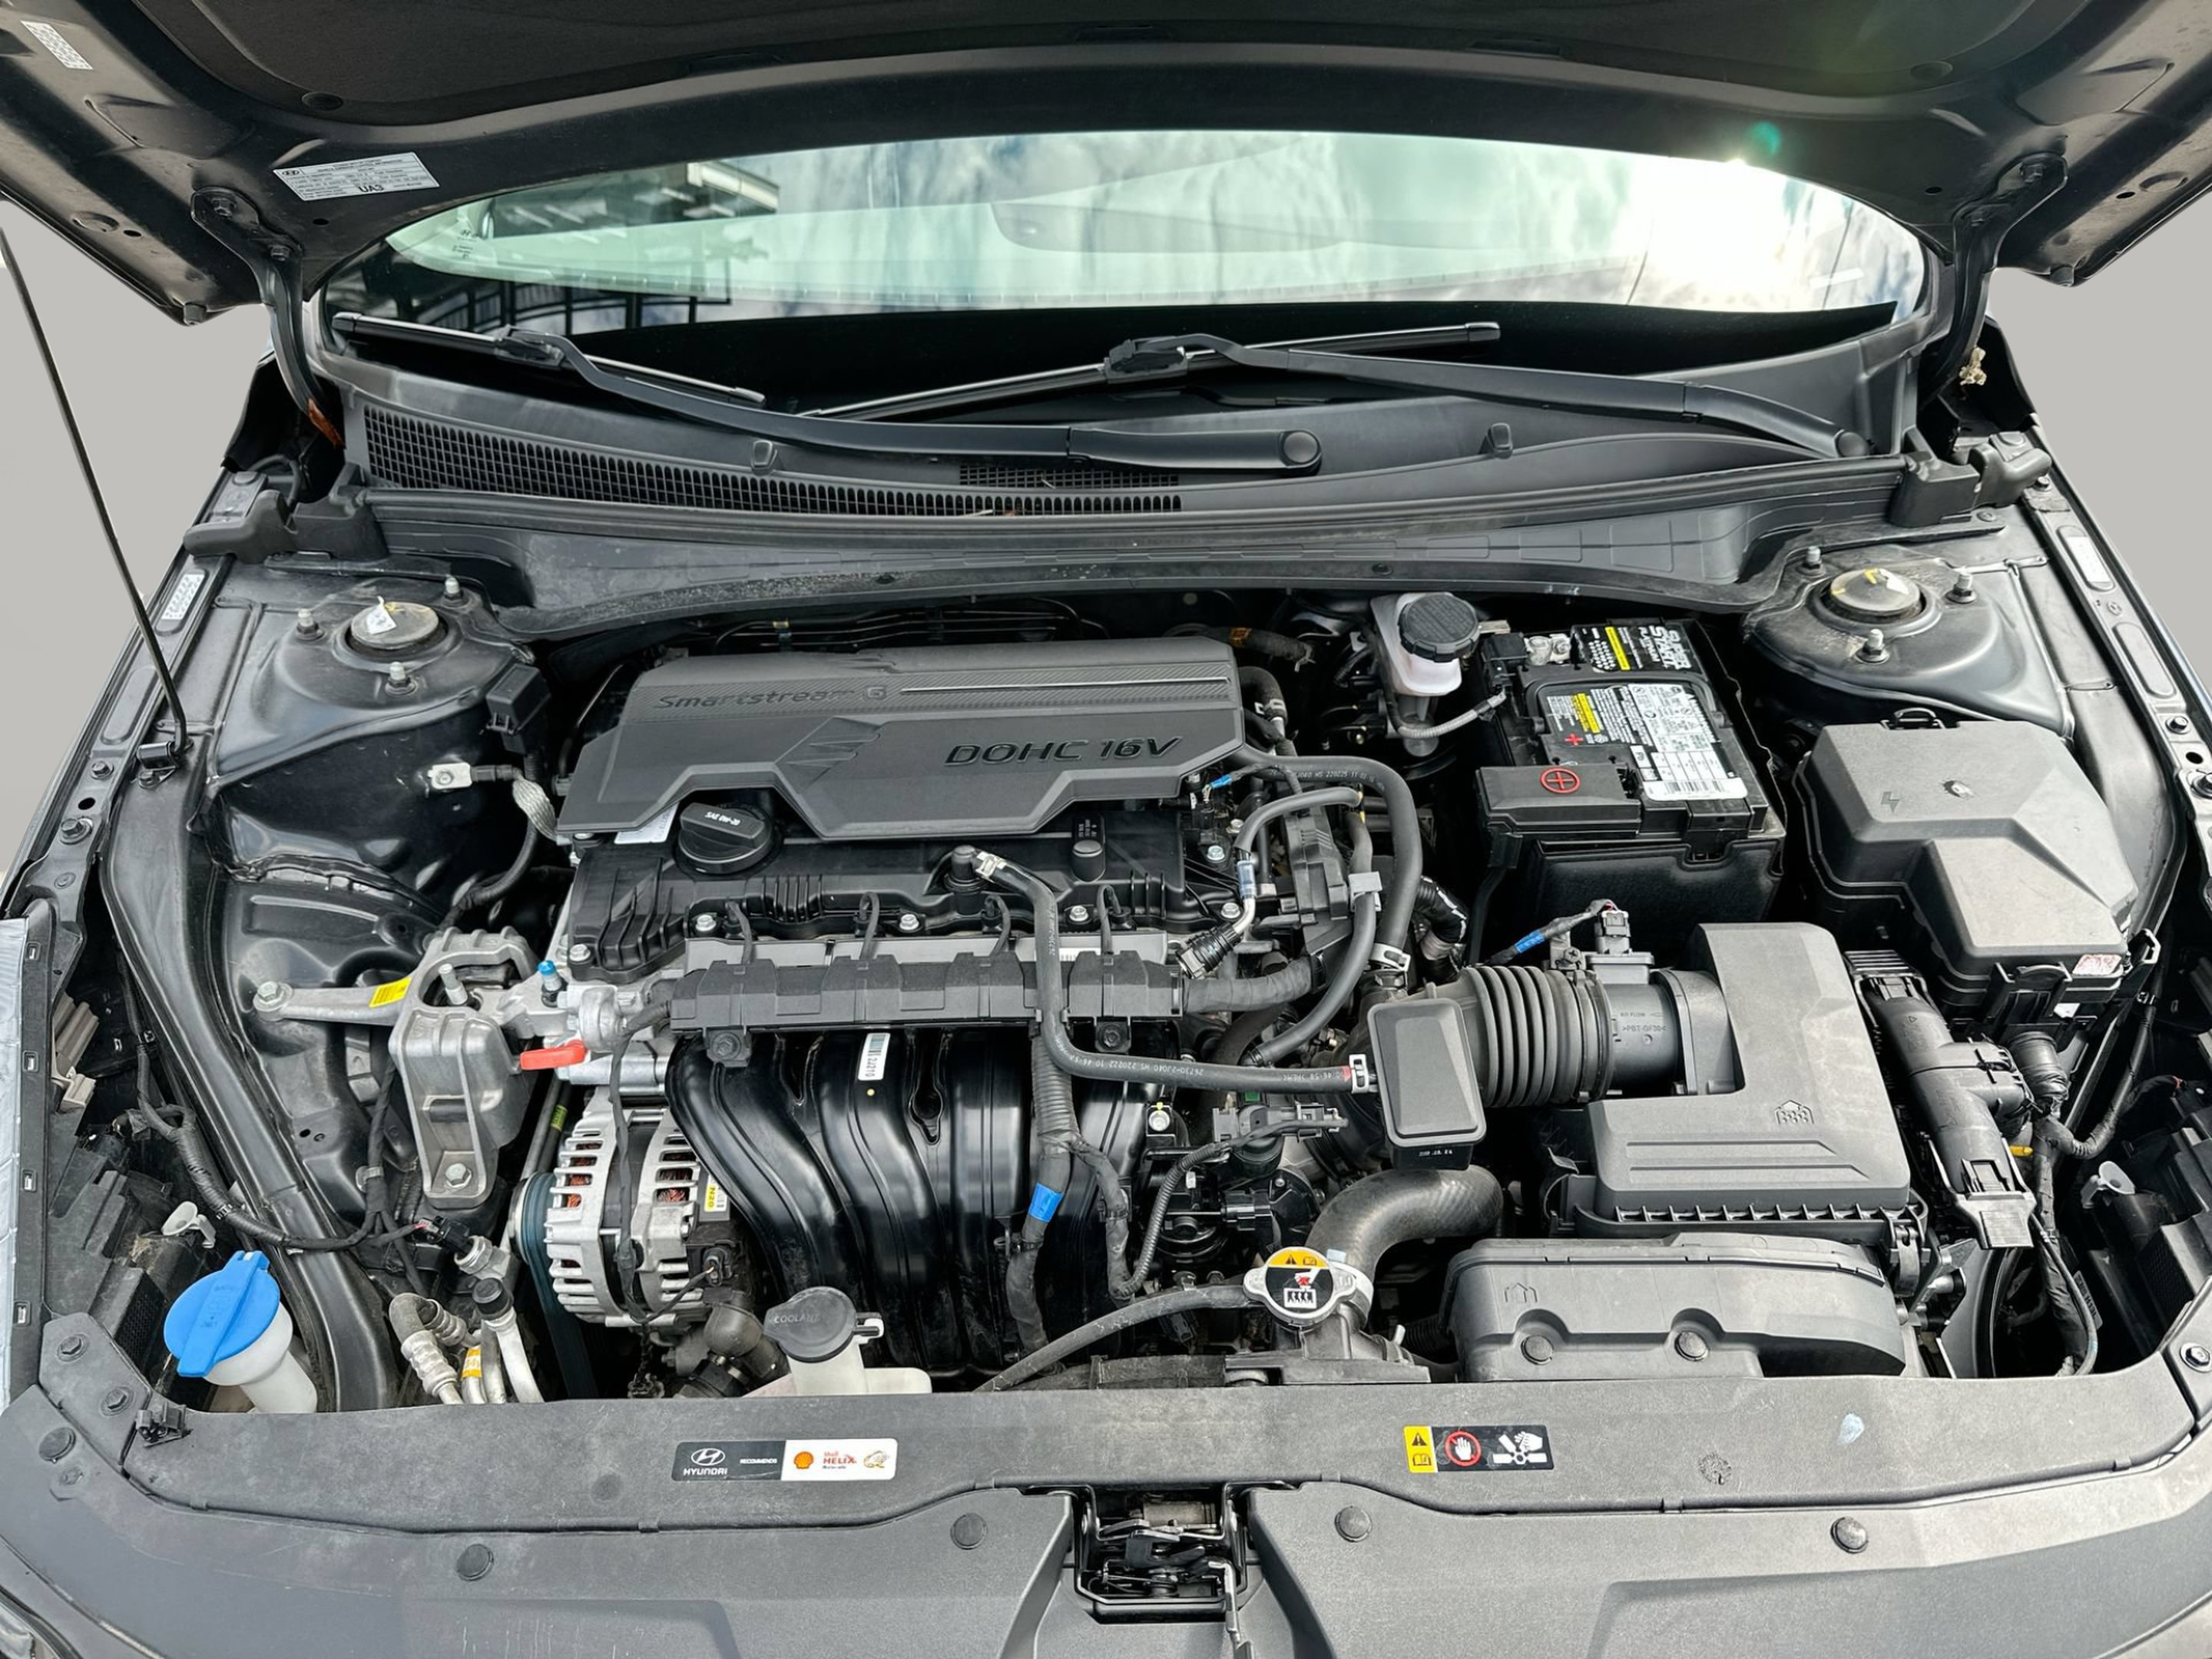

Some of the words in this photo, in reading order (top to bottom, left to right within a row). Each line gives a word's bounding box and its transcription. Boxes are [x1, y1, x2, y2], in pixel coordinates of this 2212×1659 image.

[1648, 625, 1677, 668] START
[1667, 630, 1692, 670] SUPER
[944, 739, 1089, 767] DOHC
[1100, 735, 1185, 760] 16V
[682, 1467, 729, 1475] HYUNDAI
[823, 1454, 857, 1465] HELIX
